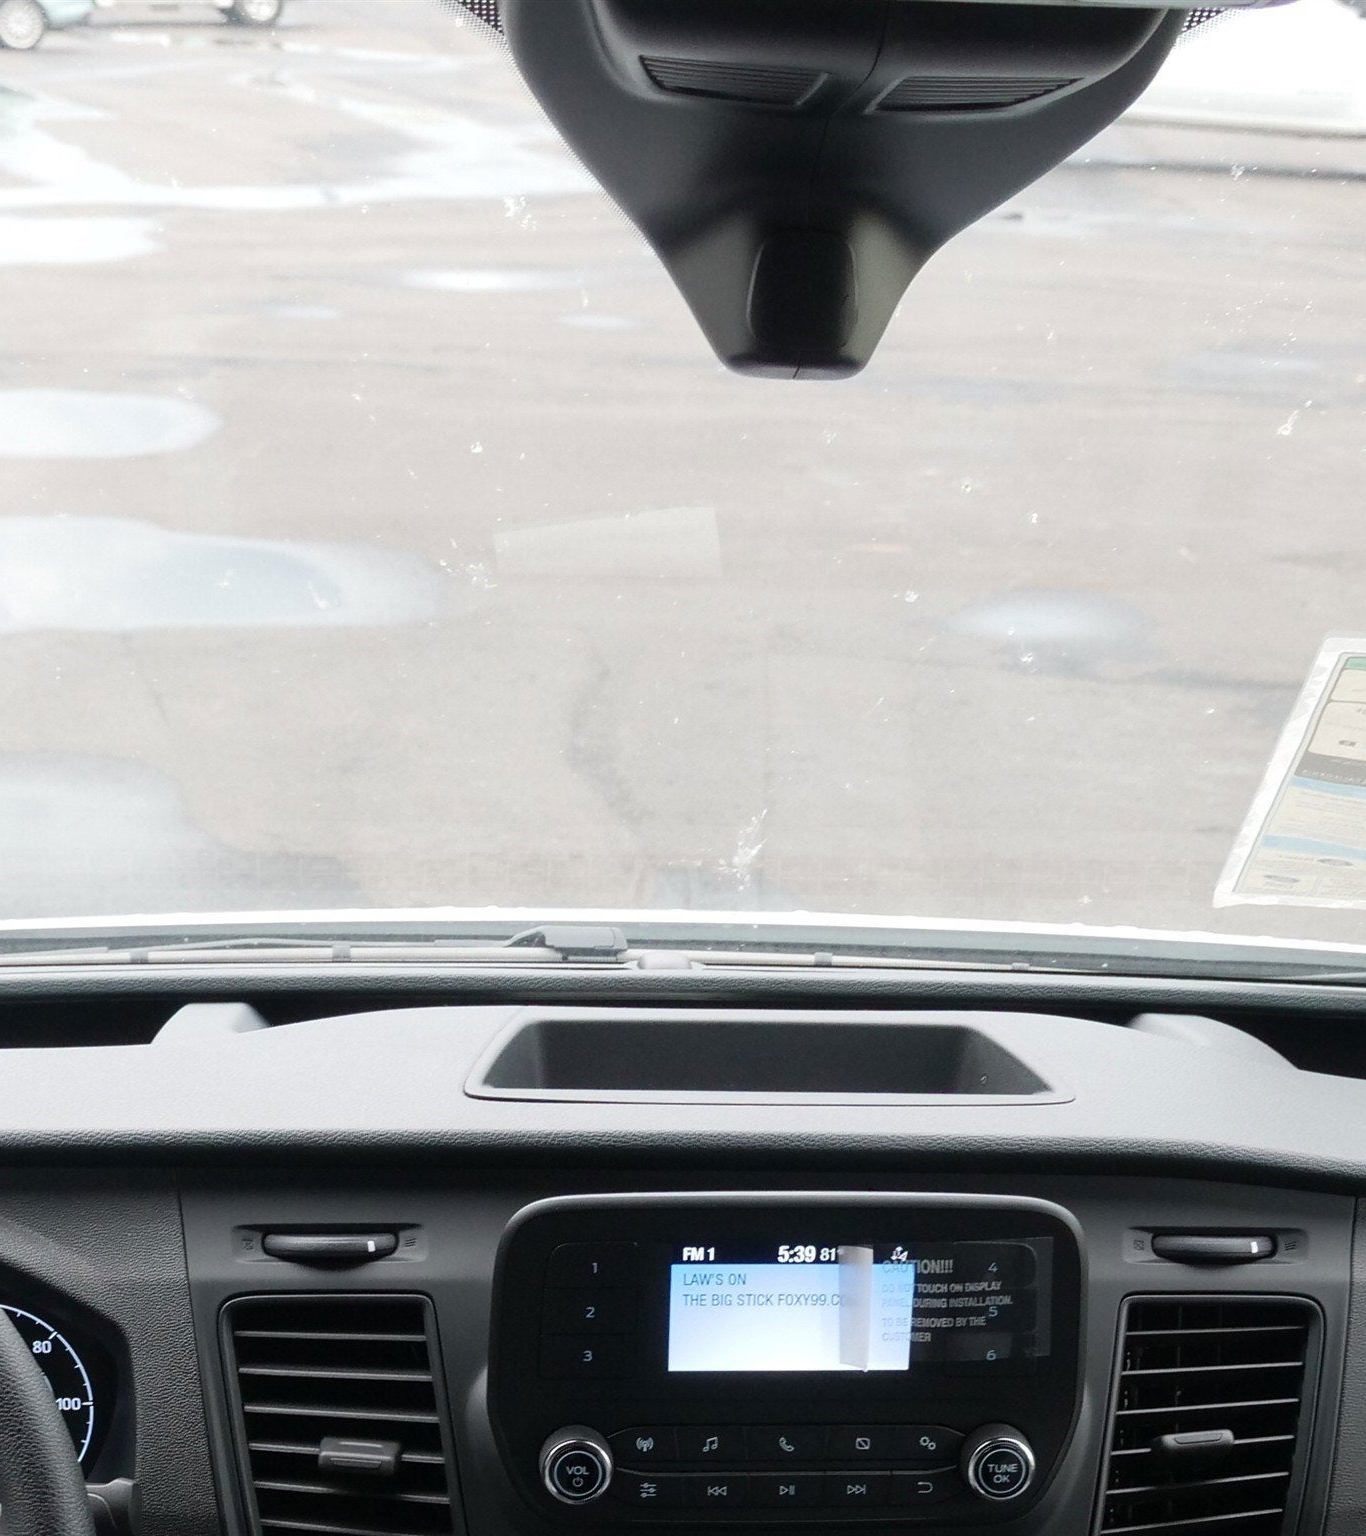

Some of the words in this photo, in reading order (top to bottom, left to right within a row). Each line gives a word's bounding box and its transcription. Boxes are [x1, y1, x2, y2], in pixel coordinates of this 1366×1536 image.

[682, 1247, 705, 1261] FM
[707, 1247, 715, 1261] 1
[777, 1245, 817, 1263] 5:39
[591, 1262, 598, 1274] 1
[987, 1262, 999, 1274] 4
[683, 1273, 724, 1286] LAW'S
[728, 1273, 747, 1286] ON
[917, 1283, 949, 1294] TOUCH
[949, 1282, 964, 1293] ON
[964, 1281, 1003, 1292] DISPLAY
[683, 1293, 707, 1307] THE
[711, 1293, 733, 1307] BIG
[737, 1293, 773, 1307] STICK
[777, 1293, 842, 1307] FOXY99.C
[912, 1297, 948, 1309] DURING
[585, 1306, 596, 1318] 2
[988, 1305, 998, 1318] 5
[910, 1317, 954, 1328] REMOVED
[955, 1317, 968, 1327] BY
[968, 1316, 987, 1326] THE
[32, 1340, 52, 1354] 80
[582, 1350, 593, 1362] 3
[986, 1349, 997, 1361] 6
[55, 1397, 82, 1412] 100
[565, 1465, 590, 1475] VOL
[986, 1463, 1019, 1474] TUNE
[992, 1474, 1011, 1485] OK
